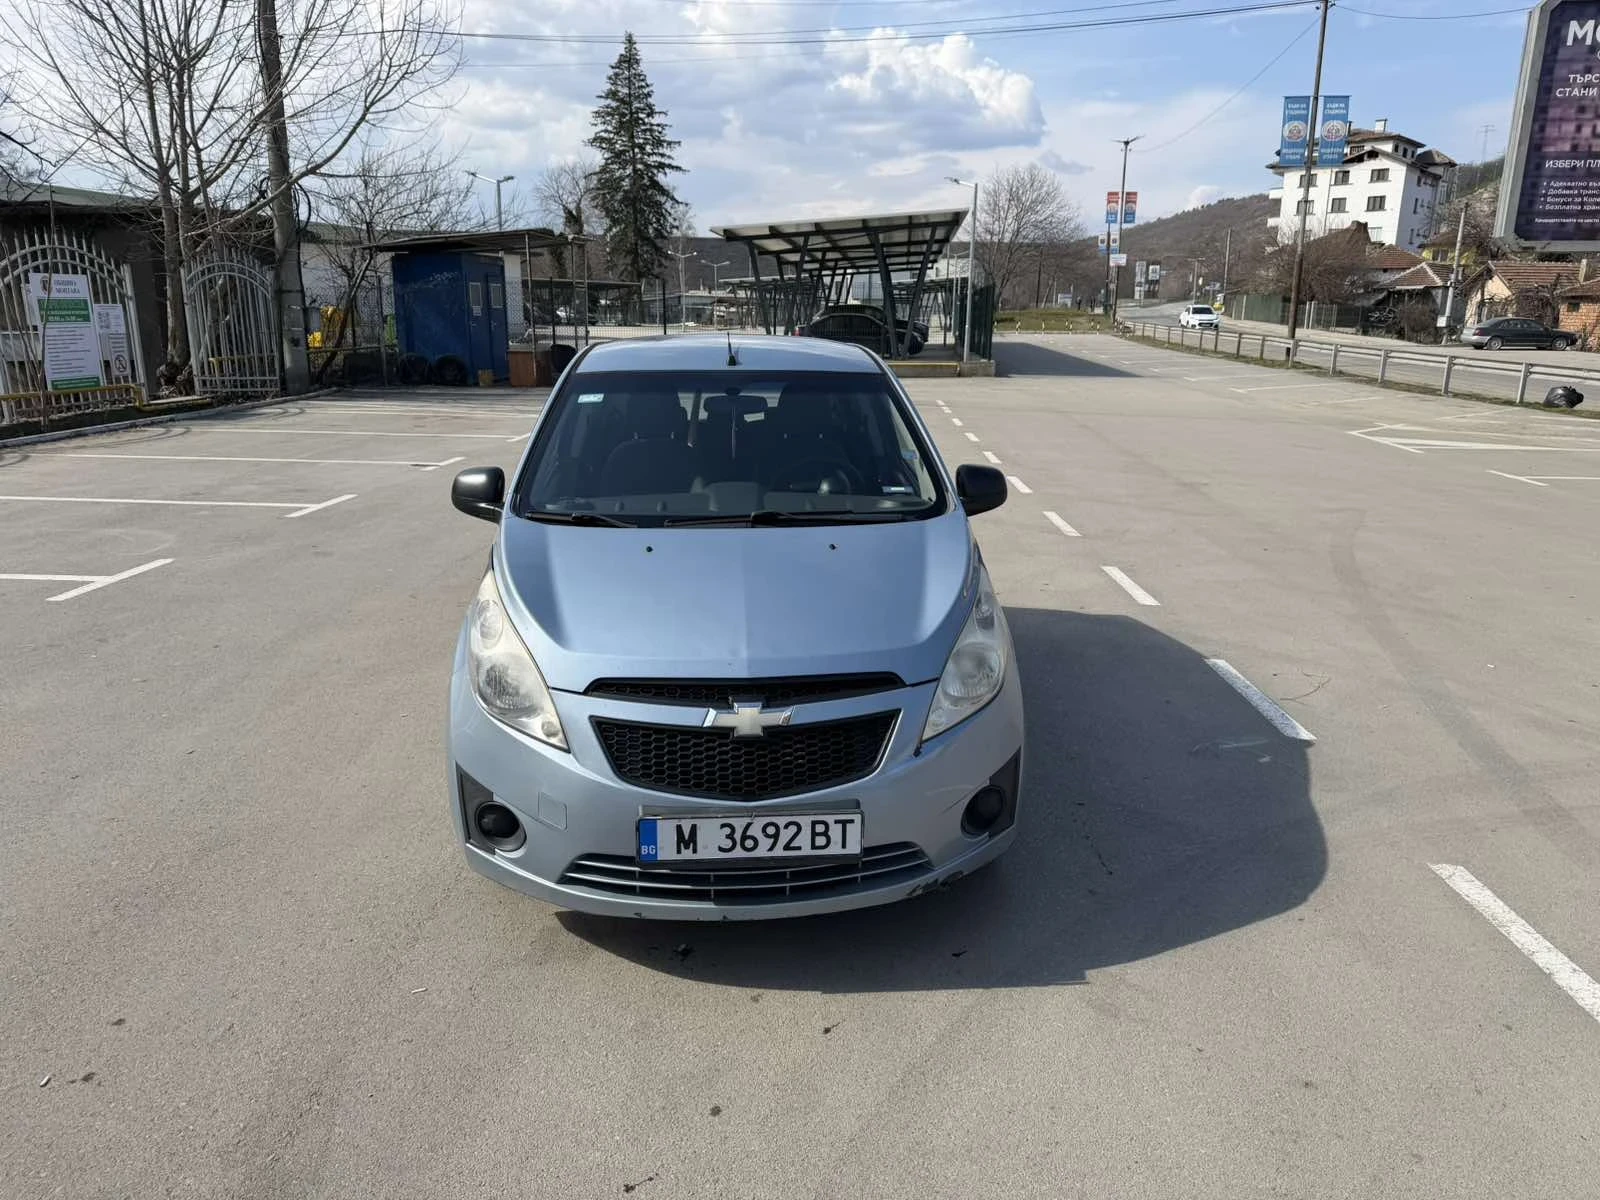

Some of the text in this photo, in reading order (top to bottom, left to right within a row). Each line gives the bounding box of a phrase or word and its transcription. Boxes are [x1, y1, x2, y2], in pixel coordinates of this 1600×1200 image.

[1566, 19, 1600, 46] М
[1568, 73, 1600, 83] ТЪРС
[1556, 87, 1598, 97] СТАНИ
[1545, 159, 1585, 168] ИЗБЕРИ
[675, 823, 698, 855] M
[718, 820, 802, 853] 3692
[641, 845, 656, 855] BG
